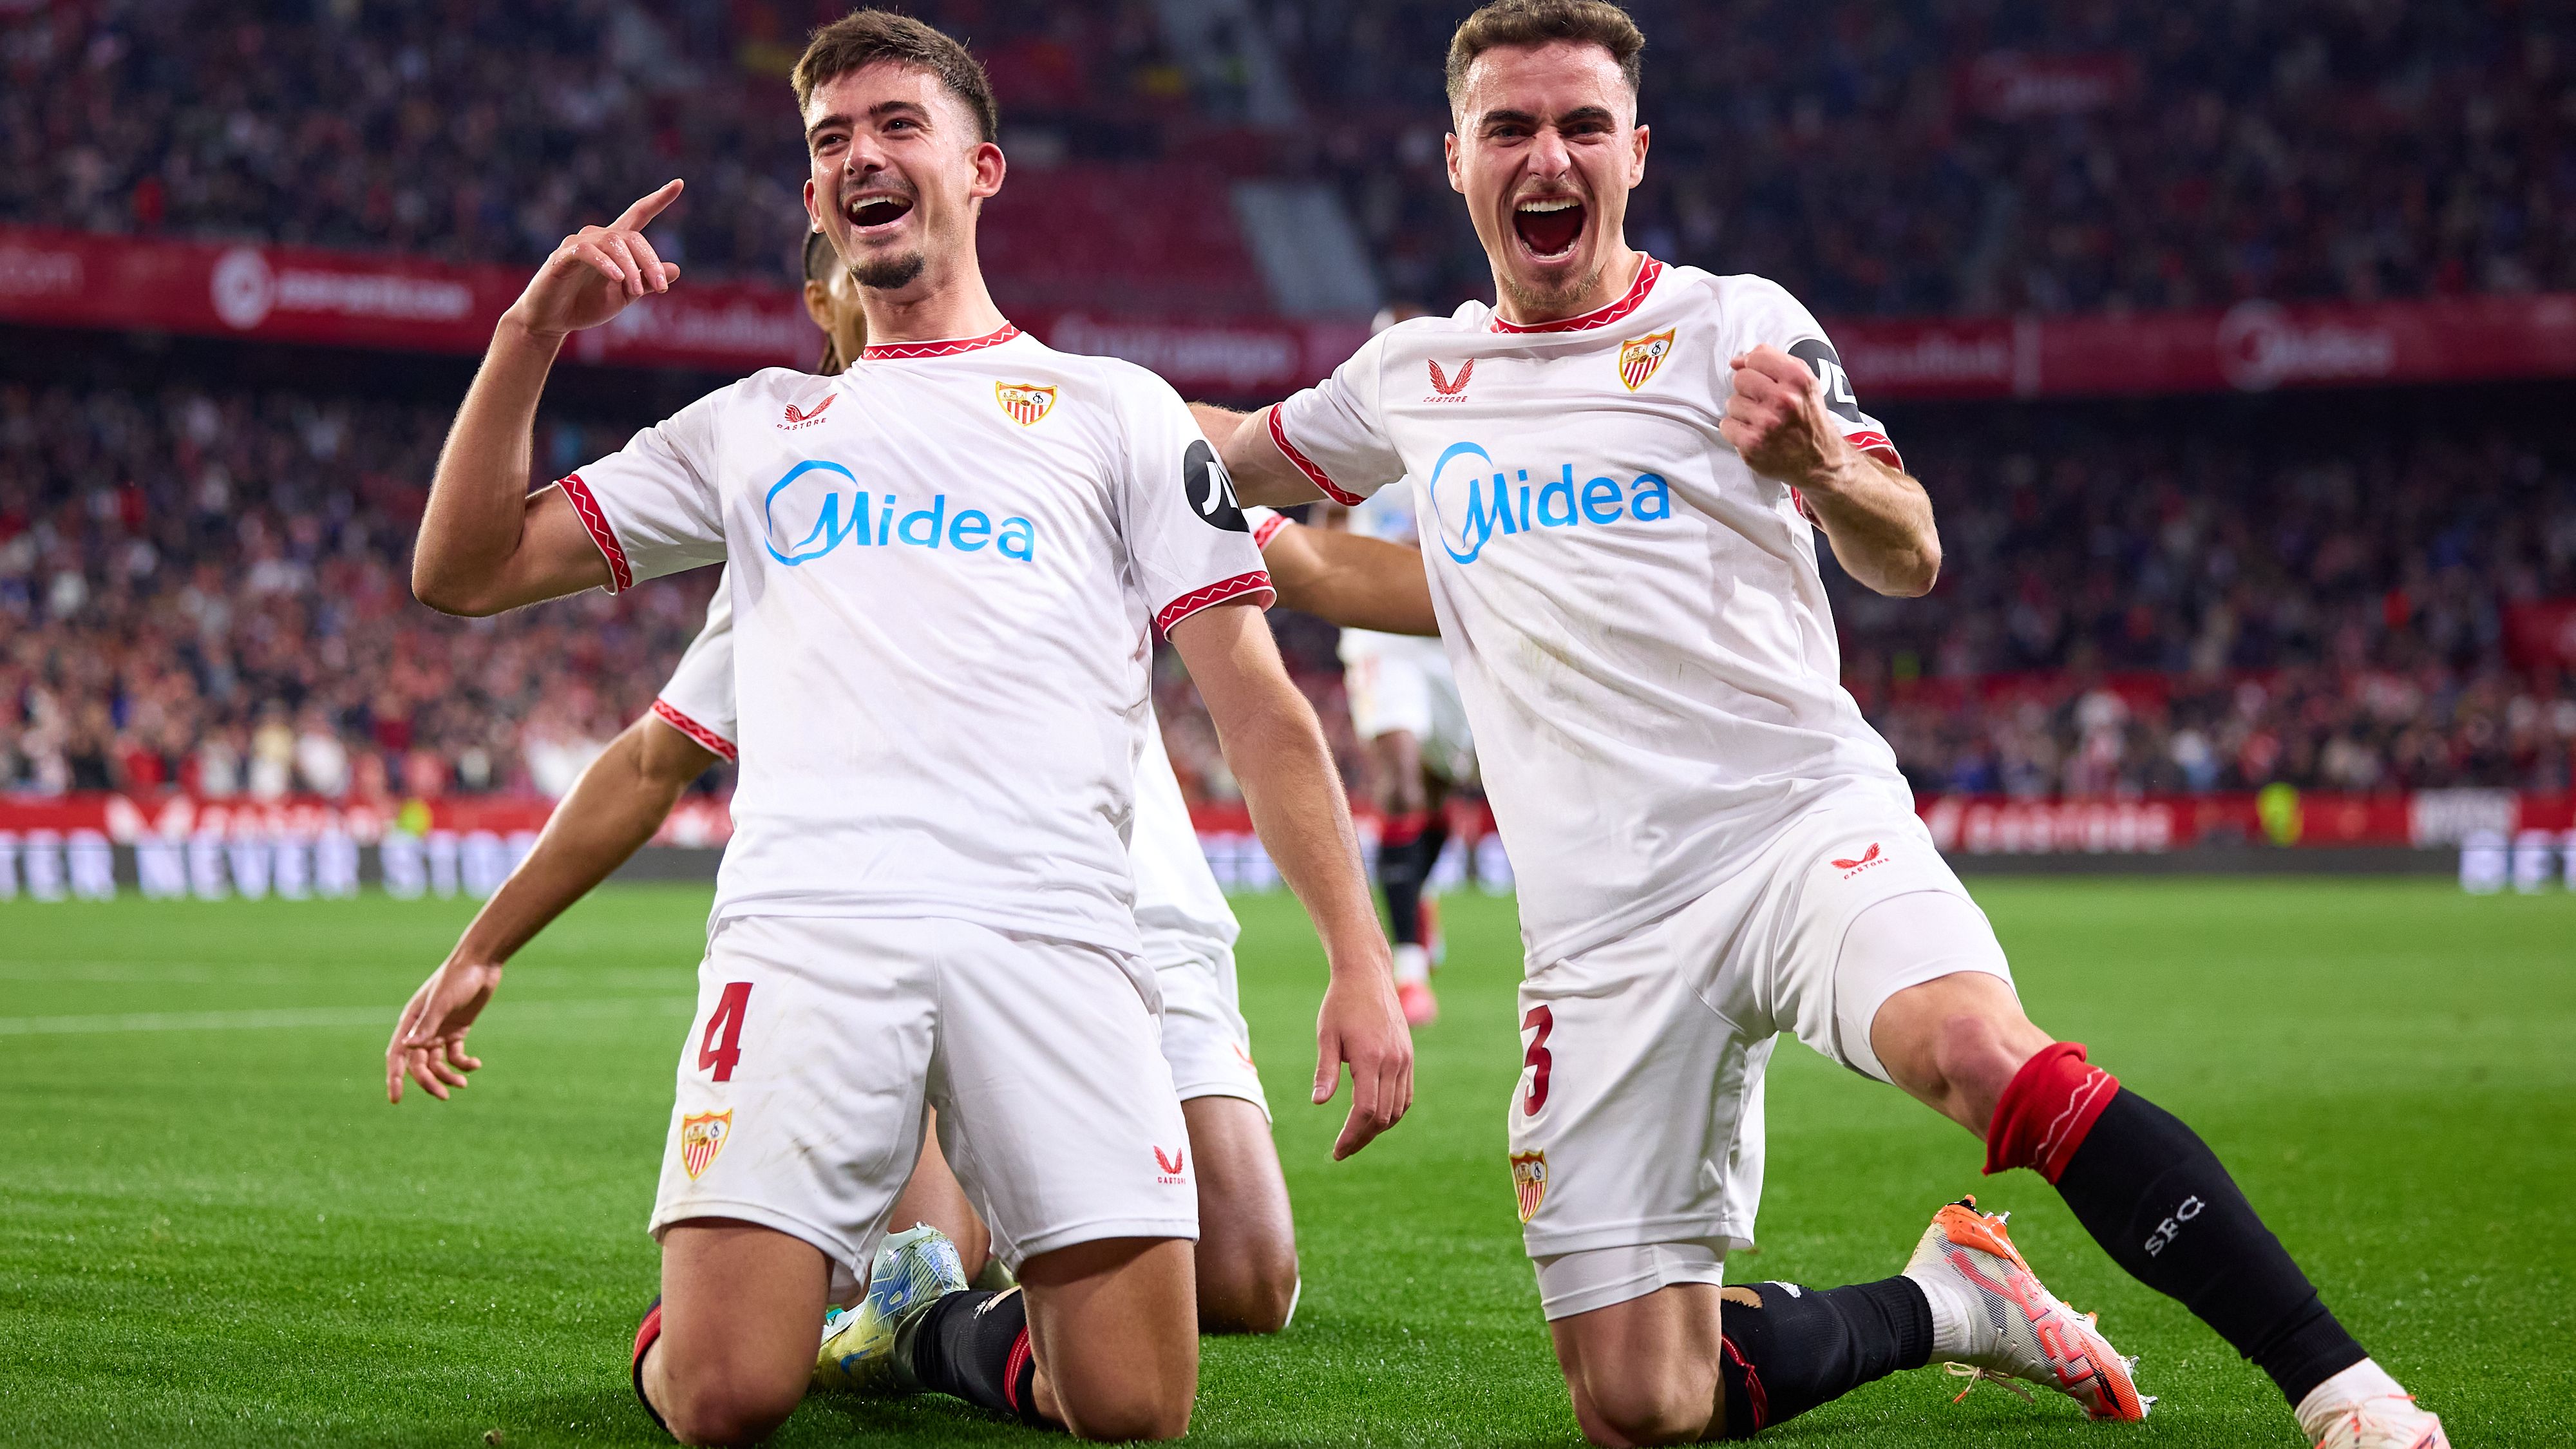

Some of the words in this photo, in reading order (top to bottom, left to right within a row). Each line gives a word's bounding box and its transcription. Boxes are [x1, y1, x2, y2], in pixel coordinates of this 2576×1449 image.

[777, 417, 827, 430] CASTORE
[765, 460, 1034, 567] Midea
[1430, 442, 1671, 564] Midea
[699, 981, 754, 1082] 4
[1520, 1004, 1553, 1117] 3
[2145, 1195, 2205, 1257] SFC
